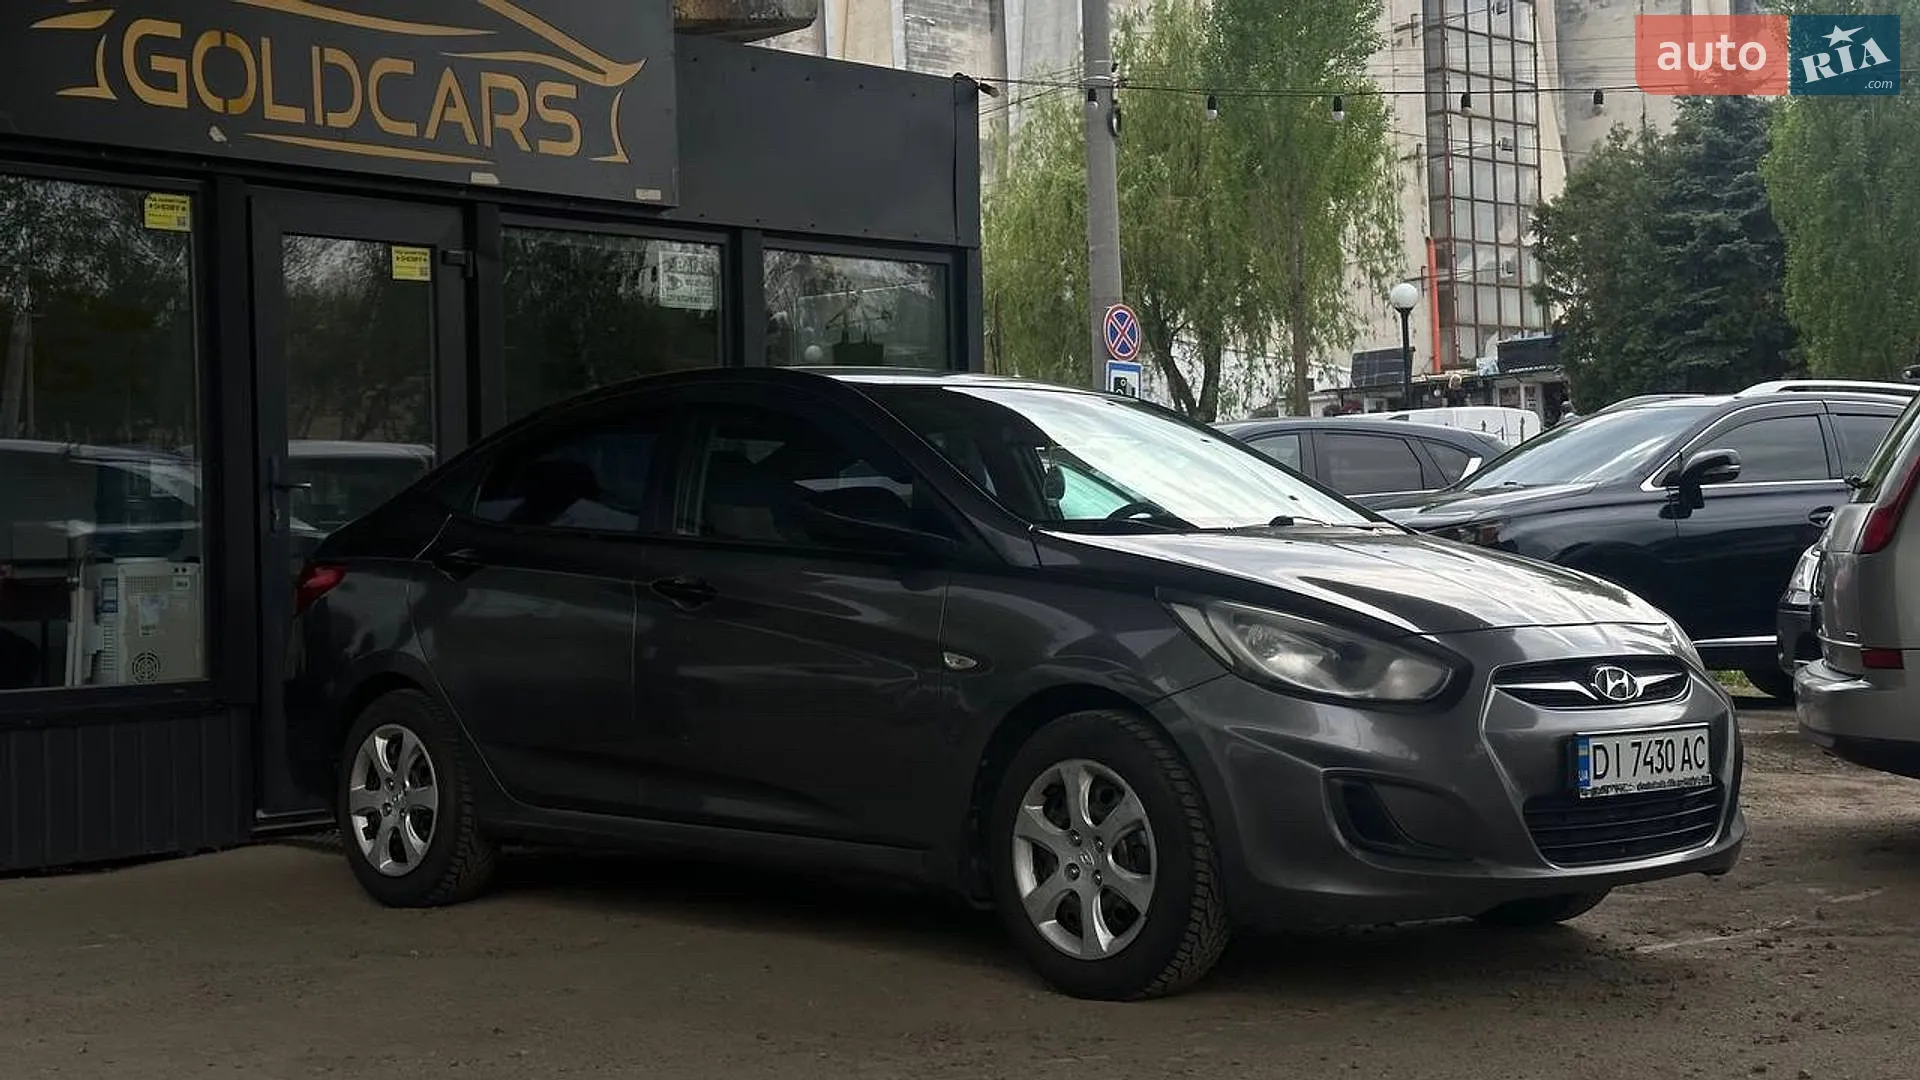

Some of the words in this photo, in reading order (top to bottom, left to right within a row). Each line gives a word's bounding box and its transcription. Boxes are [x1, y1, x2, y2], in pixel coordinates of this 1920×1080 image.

[122, 18, 581, 157] GOLDCARS
[1593, 743, 1620, 779] DI
[1631, 739, 1675, 777] 7430
[1681, 735, 1705, 771] AC
